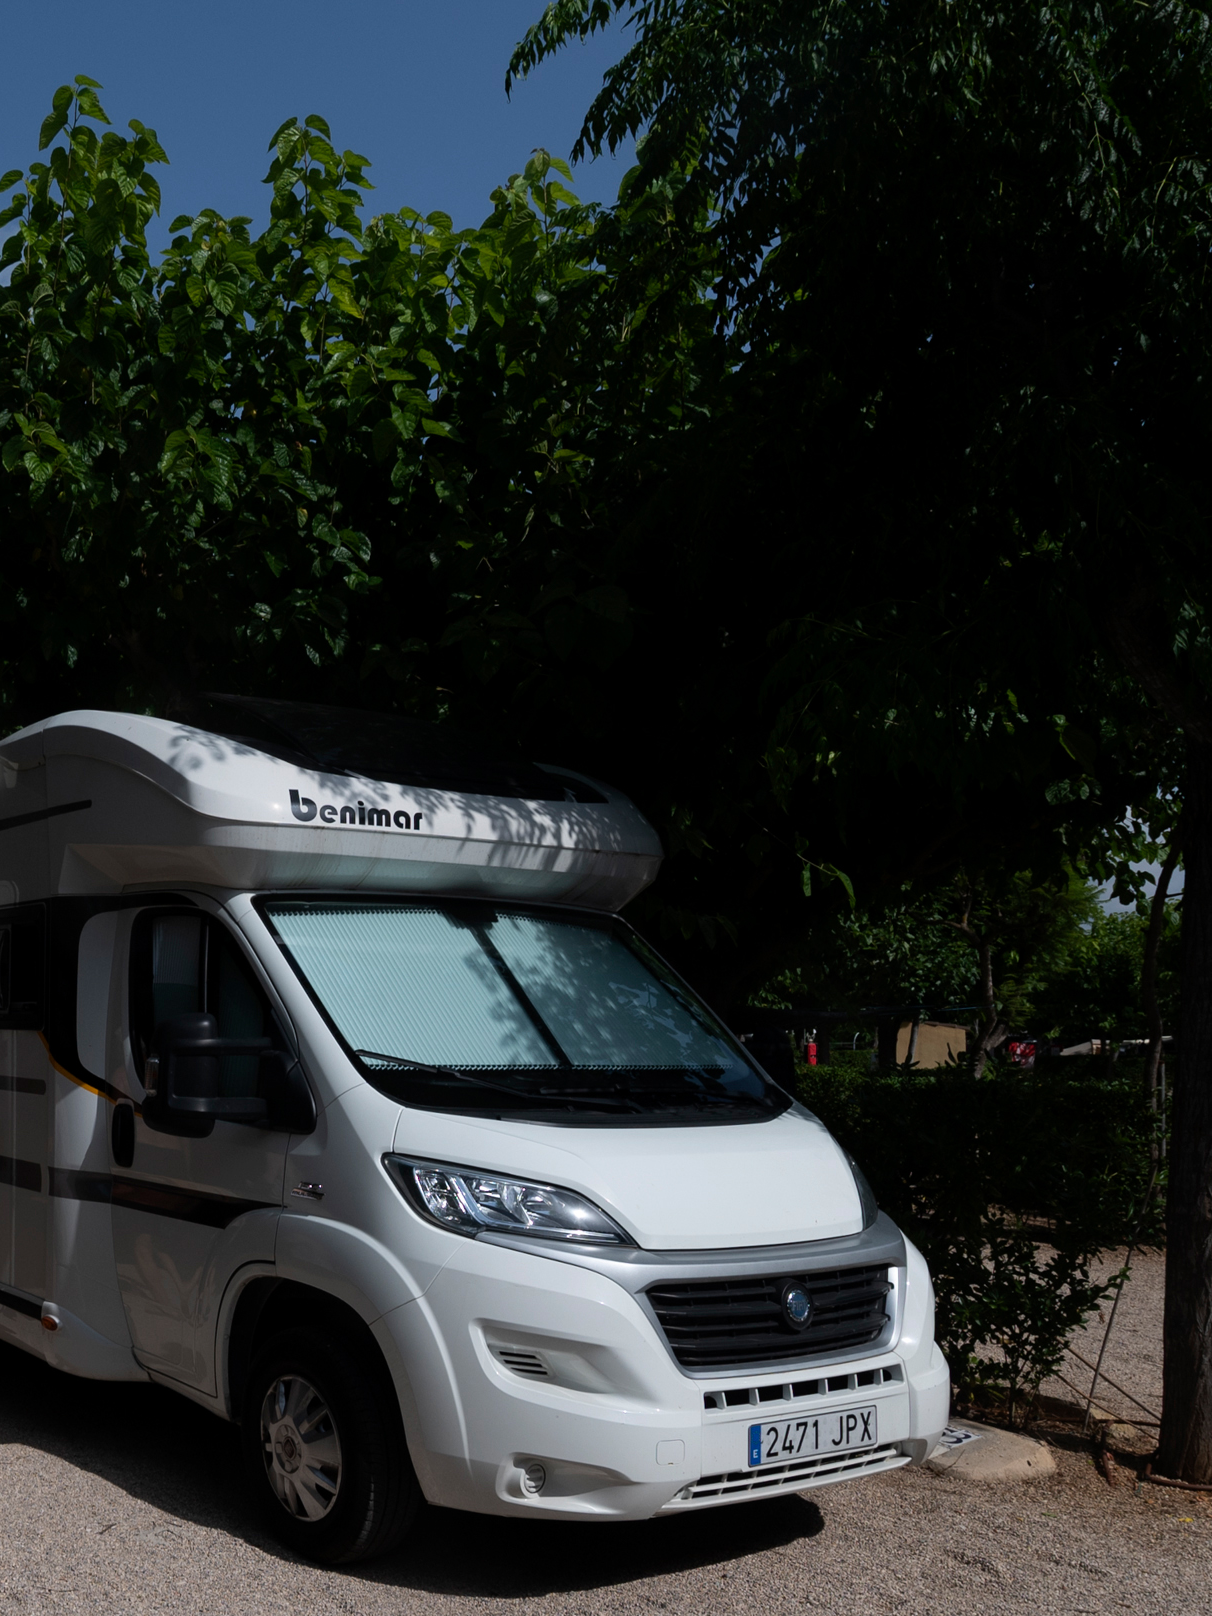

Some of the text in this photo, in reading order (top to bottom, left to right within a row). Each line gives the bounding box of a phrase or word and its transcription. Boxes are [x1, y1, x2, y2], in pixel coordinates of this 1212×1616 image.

[289, 789, 422, 830] benimar
[766, 1419, 819, 1458] 2471
[831, 1411, 872, 1446] JPX
